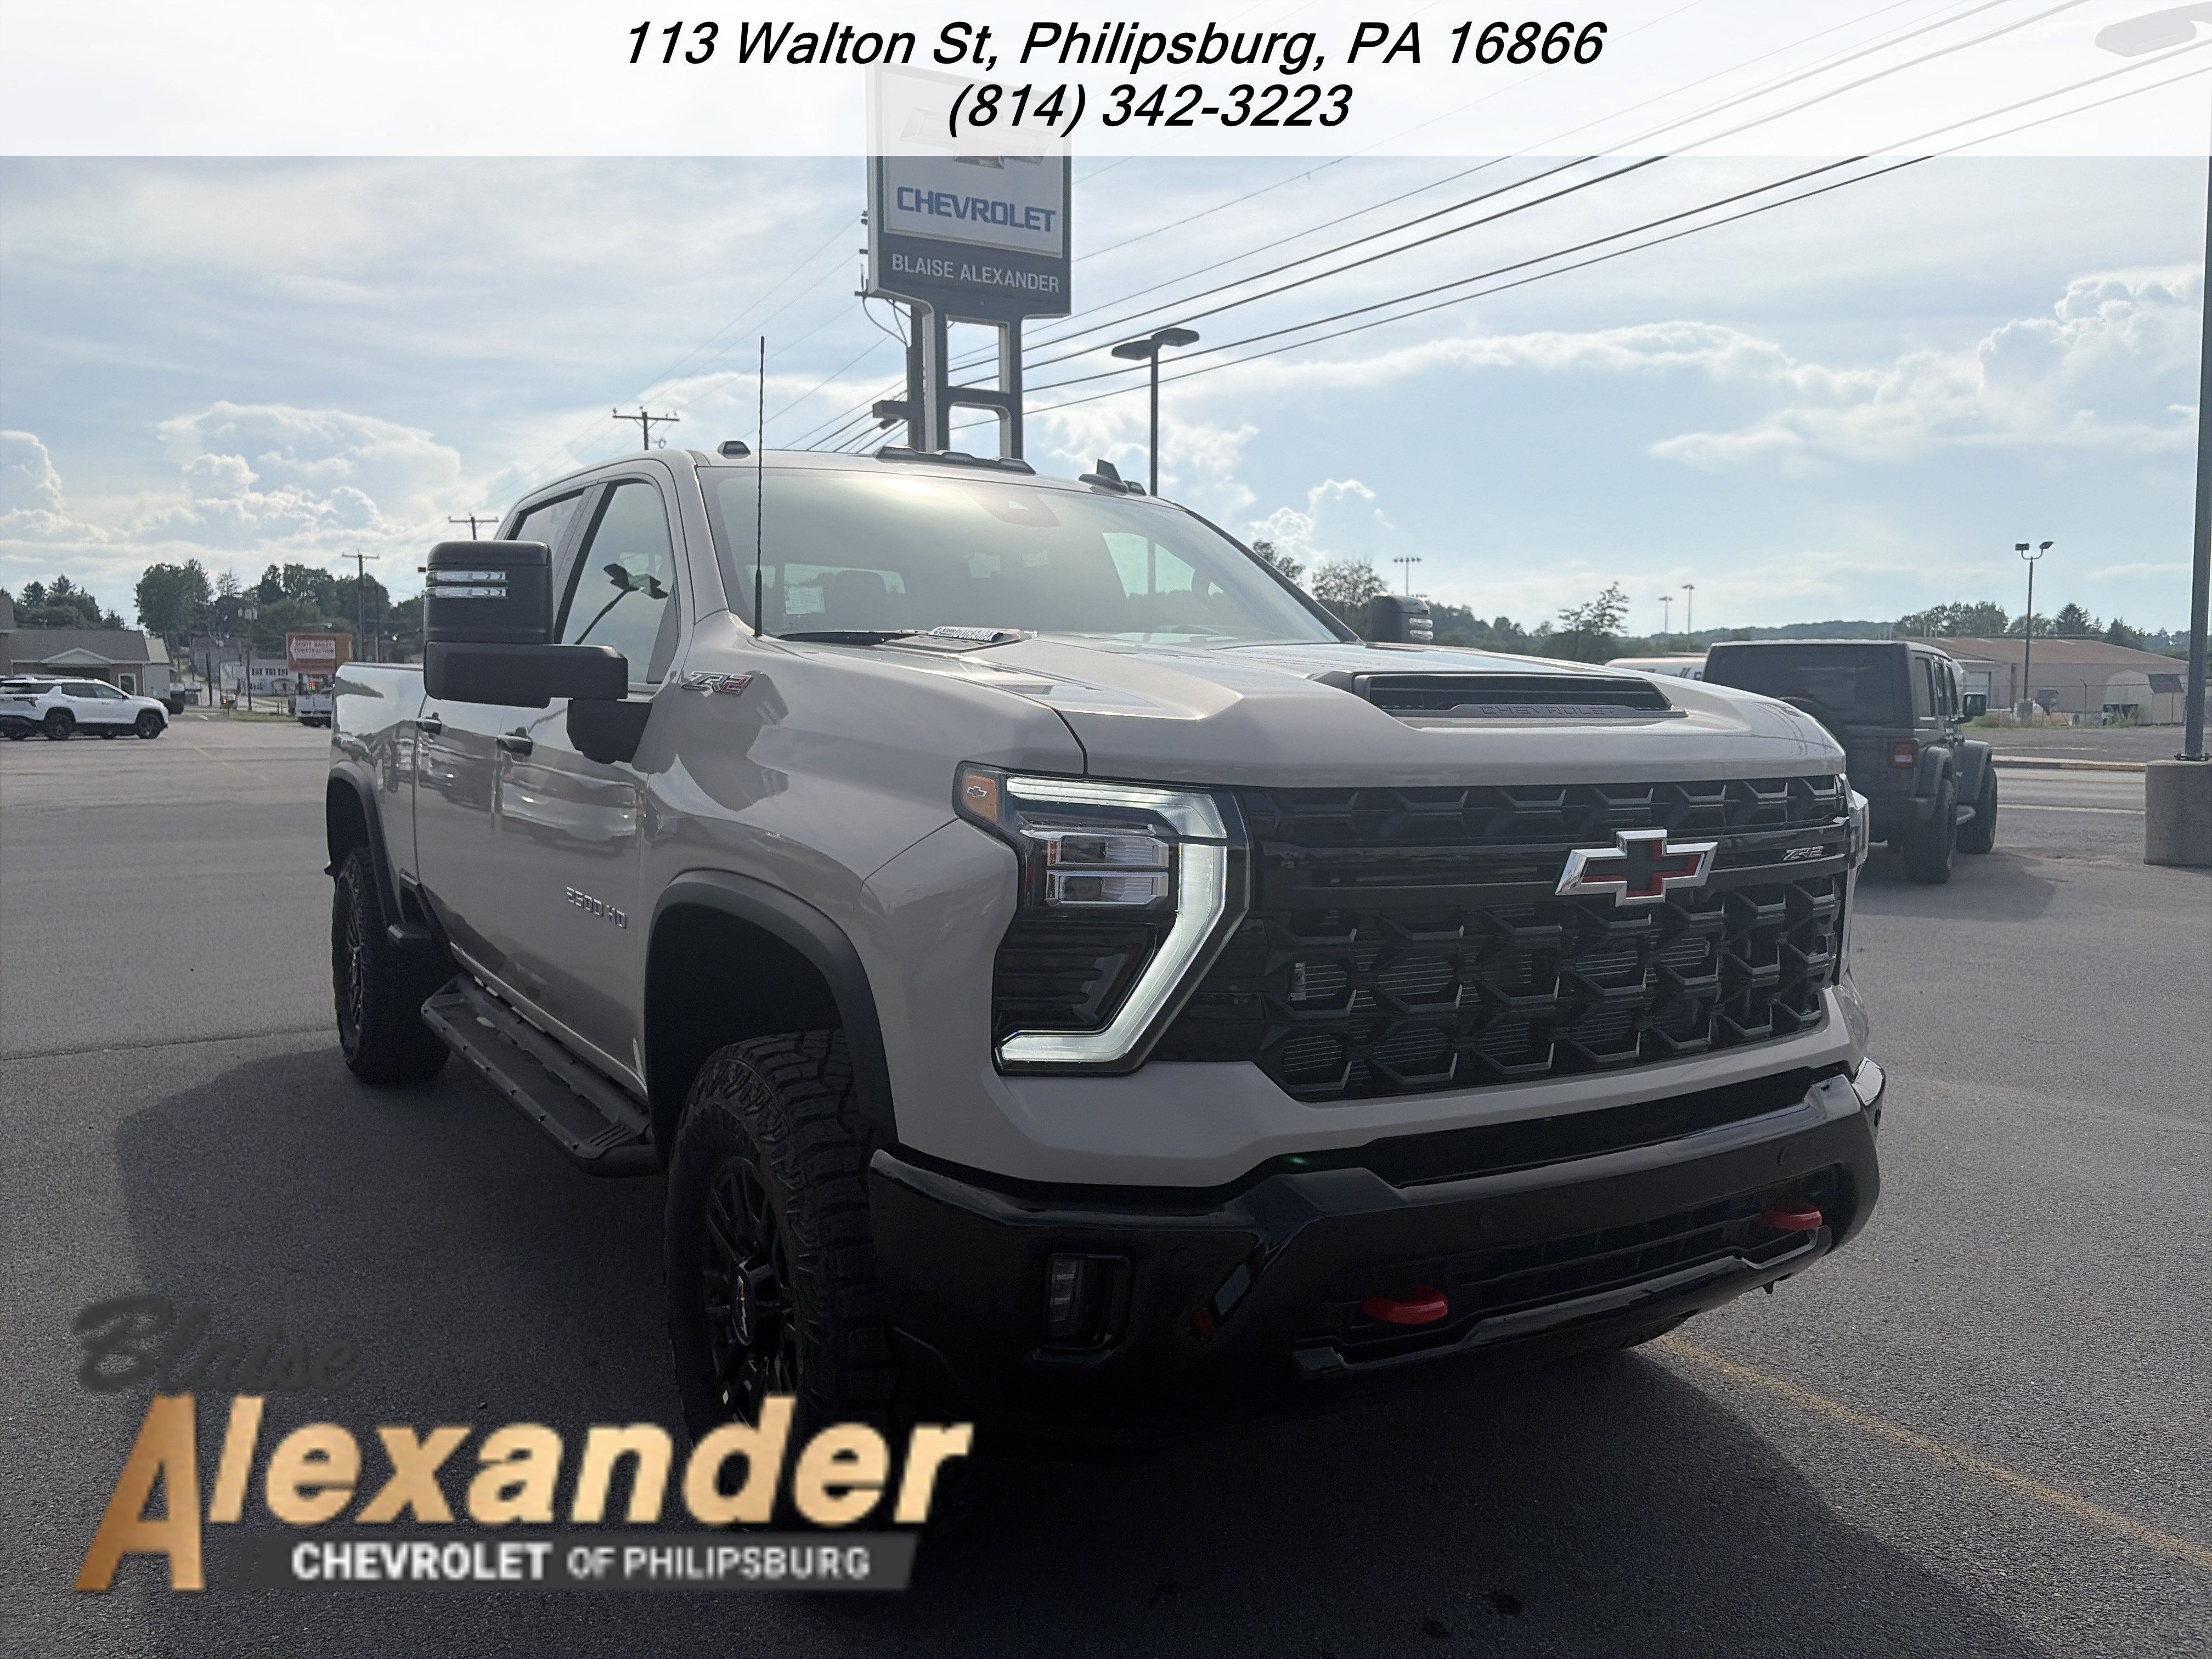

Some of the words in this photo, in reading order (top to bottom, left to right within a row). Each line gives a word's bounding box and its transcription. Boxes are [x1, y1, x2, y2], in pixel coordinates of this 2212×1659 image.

[897, 186, 1056, 233] CHEVROLET
[891, 253, 954, 279] BLAISE
[959, 263, 1059, 293] ALEXANDER
[681, 670, 753, 695] ZR2
[1479, 706, 1615, 715] CHEVROLET
[1783, 845, 1824, 861] ZR2
[606, 905, 627, 929] HD
